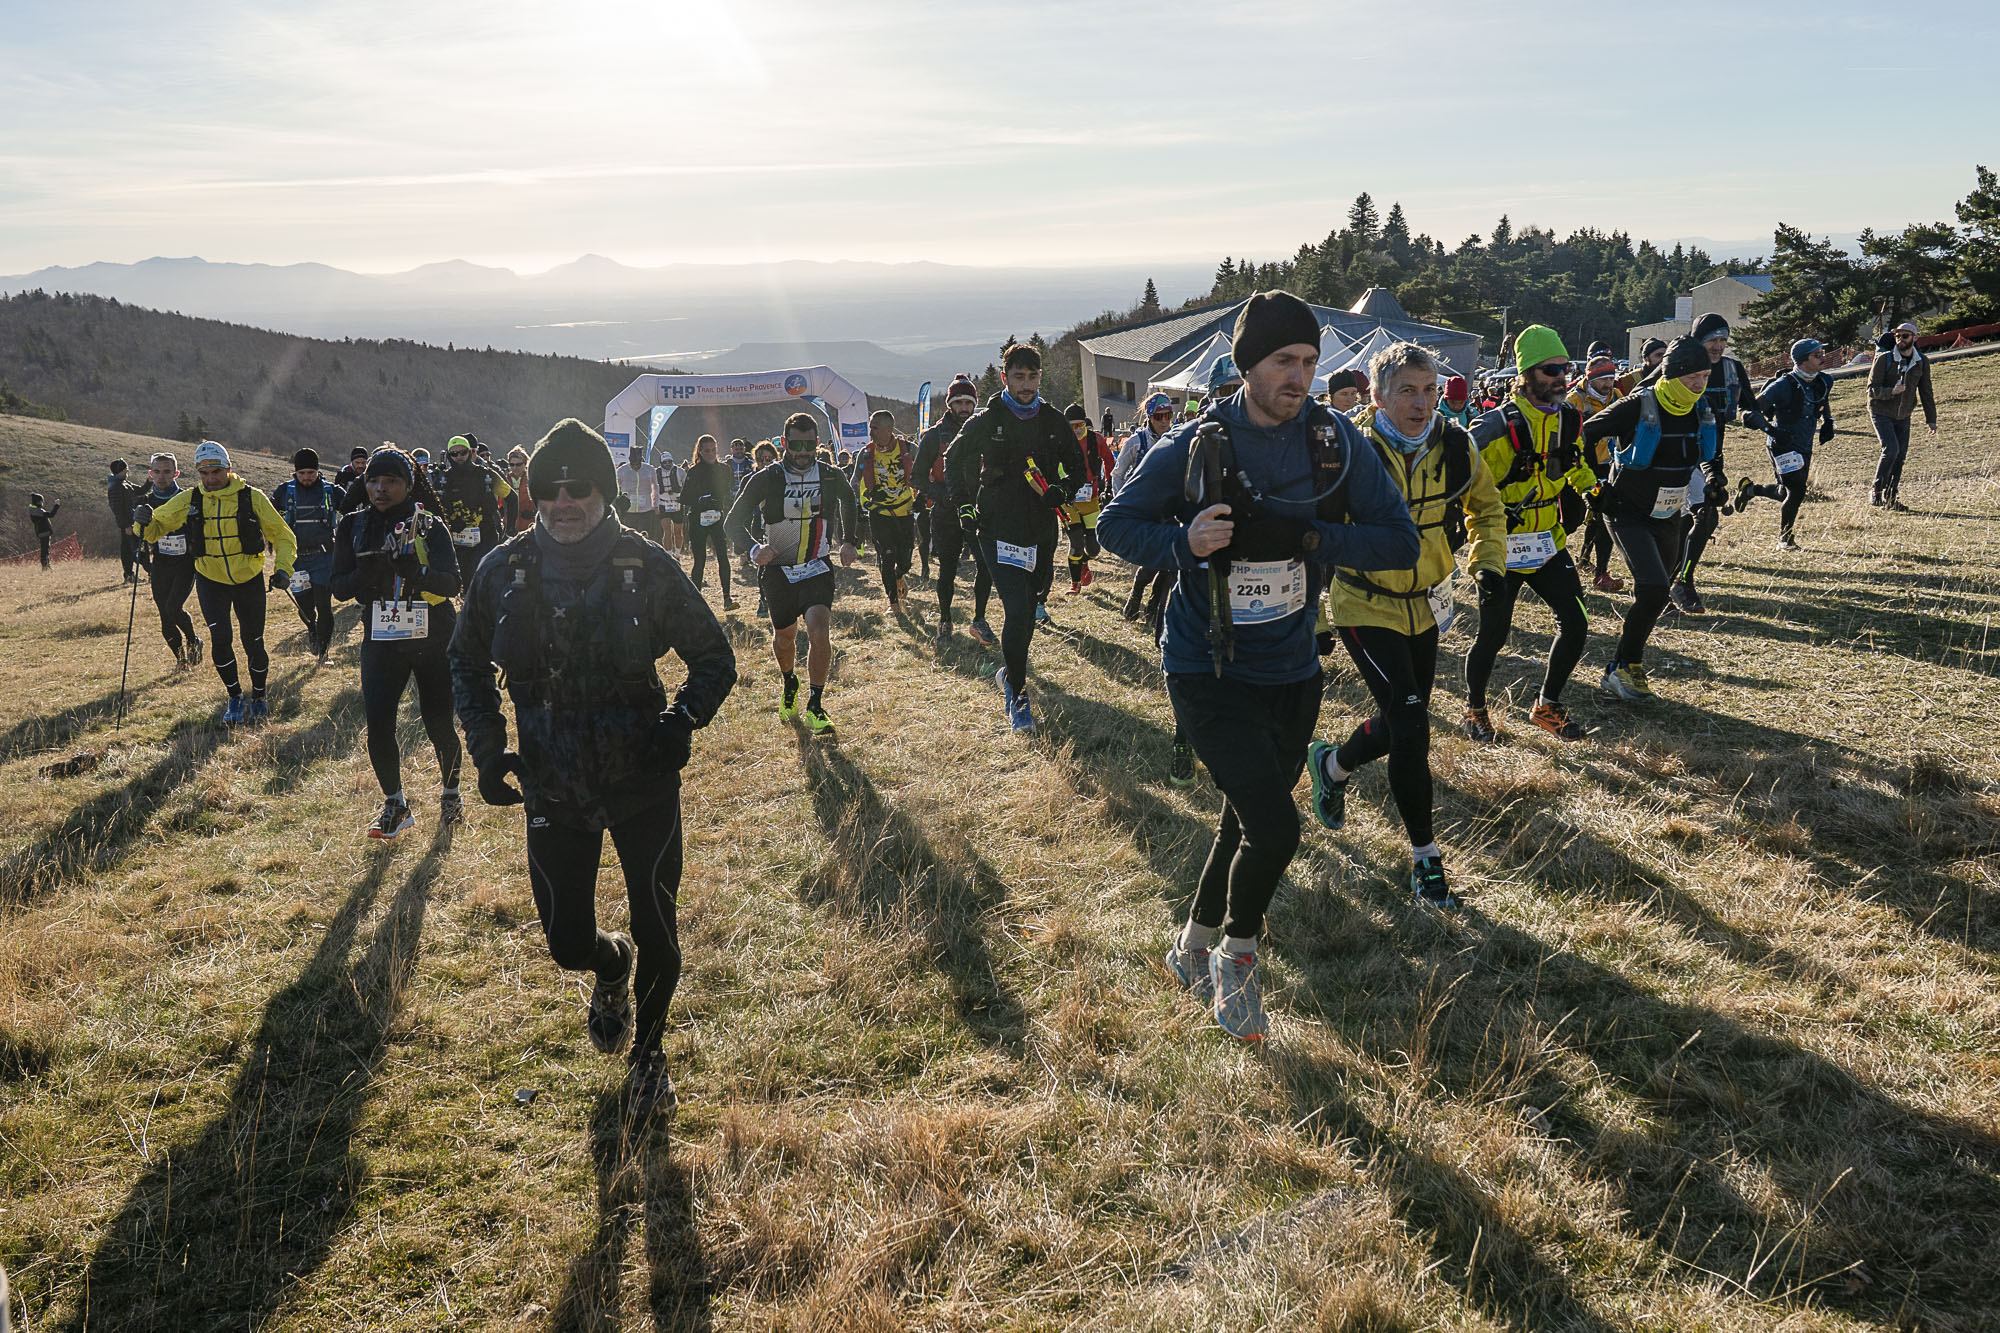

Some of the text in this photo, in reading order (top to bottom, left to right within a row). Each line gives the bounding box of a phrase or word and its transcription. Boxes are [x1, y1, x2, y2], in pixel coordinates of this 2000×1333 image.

[661, 385, 695, 398] THP
[697, 385, 713, 393] TRAIL
[726, 384, 748, 392] HAUTE
[749, 382, 783, 391] PROVENCE
[1512, 545, 1532, 554] 4349
[1231, 564, 1282, 575] THP winter
[1292, 568, 1301, 595] W25
[1237, 584, 1271, 596] 2249
[380, 614, 401, 623] 2343
[415, 610, 423, 627] W25
